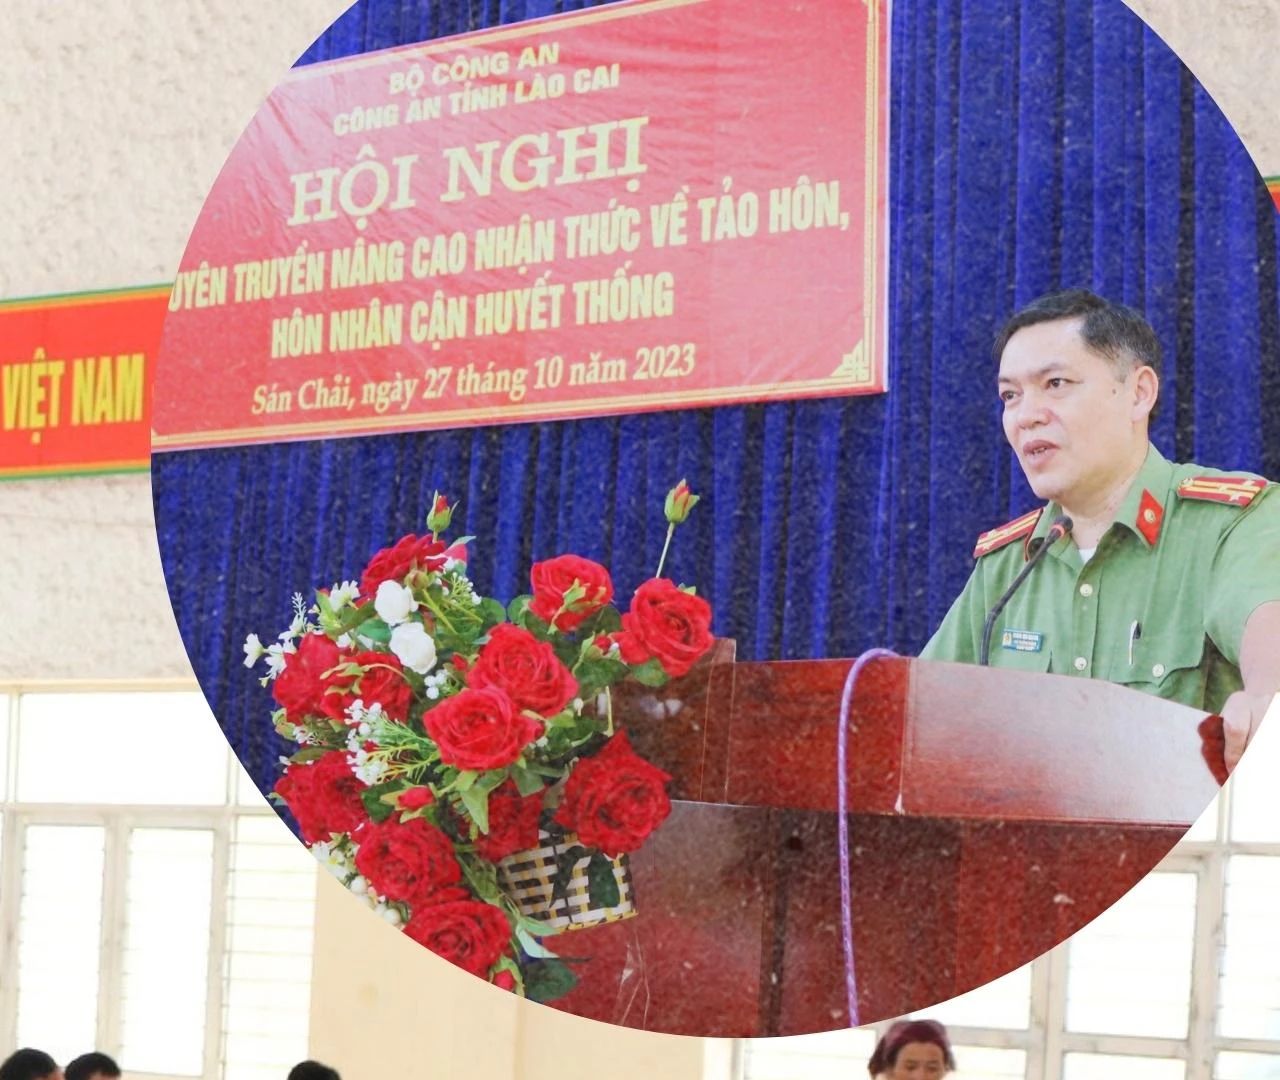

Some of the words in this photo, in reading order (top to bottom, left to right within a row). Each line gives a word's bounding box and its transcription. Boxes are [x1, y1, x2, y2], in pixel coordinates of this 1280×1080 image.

[333, 100, 399, 136] CÔNG
[404, 97, 441, 124] AN
[513, 73, 565, 103] LÀO
[573, 63, 620, 93] CAI
[389, 64, 425, 97] BỘ
[431, 53, 509, 86] CÔNG
[516, 42, 560, 70] AN
[286, 143, 419, 231] HỘI
[439, 116, 649, 202] NGHỊ
[233, 239, 325, 303] TRUYỀN
[330, 236, 405, 290] NÂNG
[411, 231, 467, 279] CAO
[474, 213, 556, 275] NHẬN
[563, 197, 640, 260] THỨC
[649, 184, 690, 249] VỀ
[697, 175, 759, 243] TẢO
[768, 174, 850, 234] HÔN,
[271, 307, 324, 359] HÔN
[329, 298, 403, 353] NHÂN
[409, 289, 469, 351] CẬN
[474, 270, 565, 337] HUYẾT
[572, 260, 675, 326] THỐNG
[1, 346, 67, 445] VIỆT
[71, 352, 146, 427] NAM
[251, 382, 292, 415] Sán
[361, 372, 419, 414] ngày
[422, 365, 453, 399] 27
[455, 361, 529, 402] tháng
[533, 355, 564, 390] 10
[568, 351, 627, 386] năm
[632, 342, 696, 380] 2023
